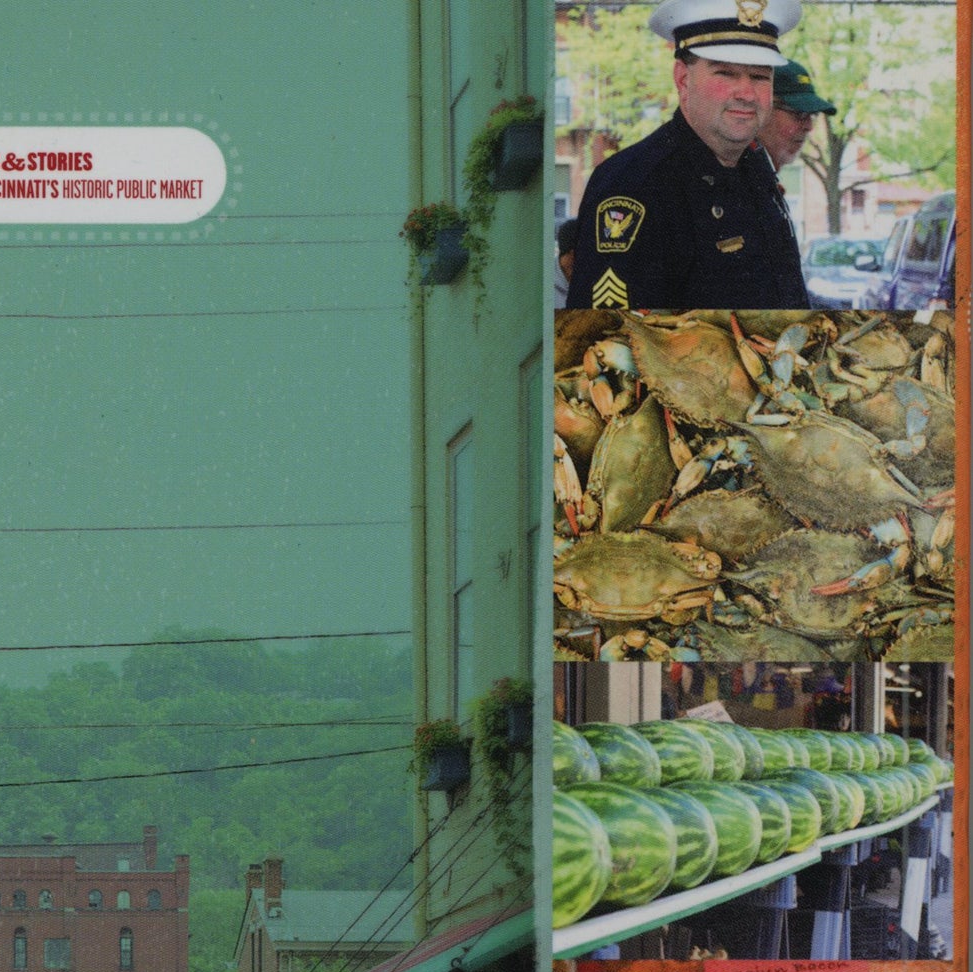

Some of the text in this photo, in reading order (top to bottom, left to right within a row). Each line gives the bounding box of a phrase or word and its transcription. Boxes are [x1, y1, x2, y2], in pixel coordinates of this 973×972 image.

[62, 179, 113, 199] HISTORIC
[116, 179, 157, 199] PUBLIC
[160, 179, 204, 199] MARKET
